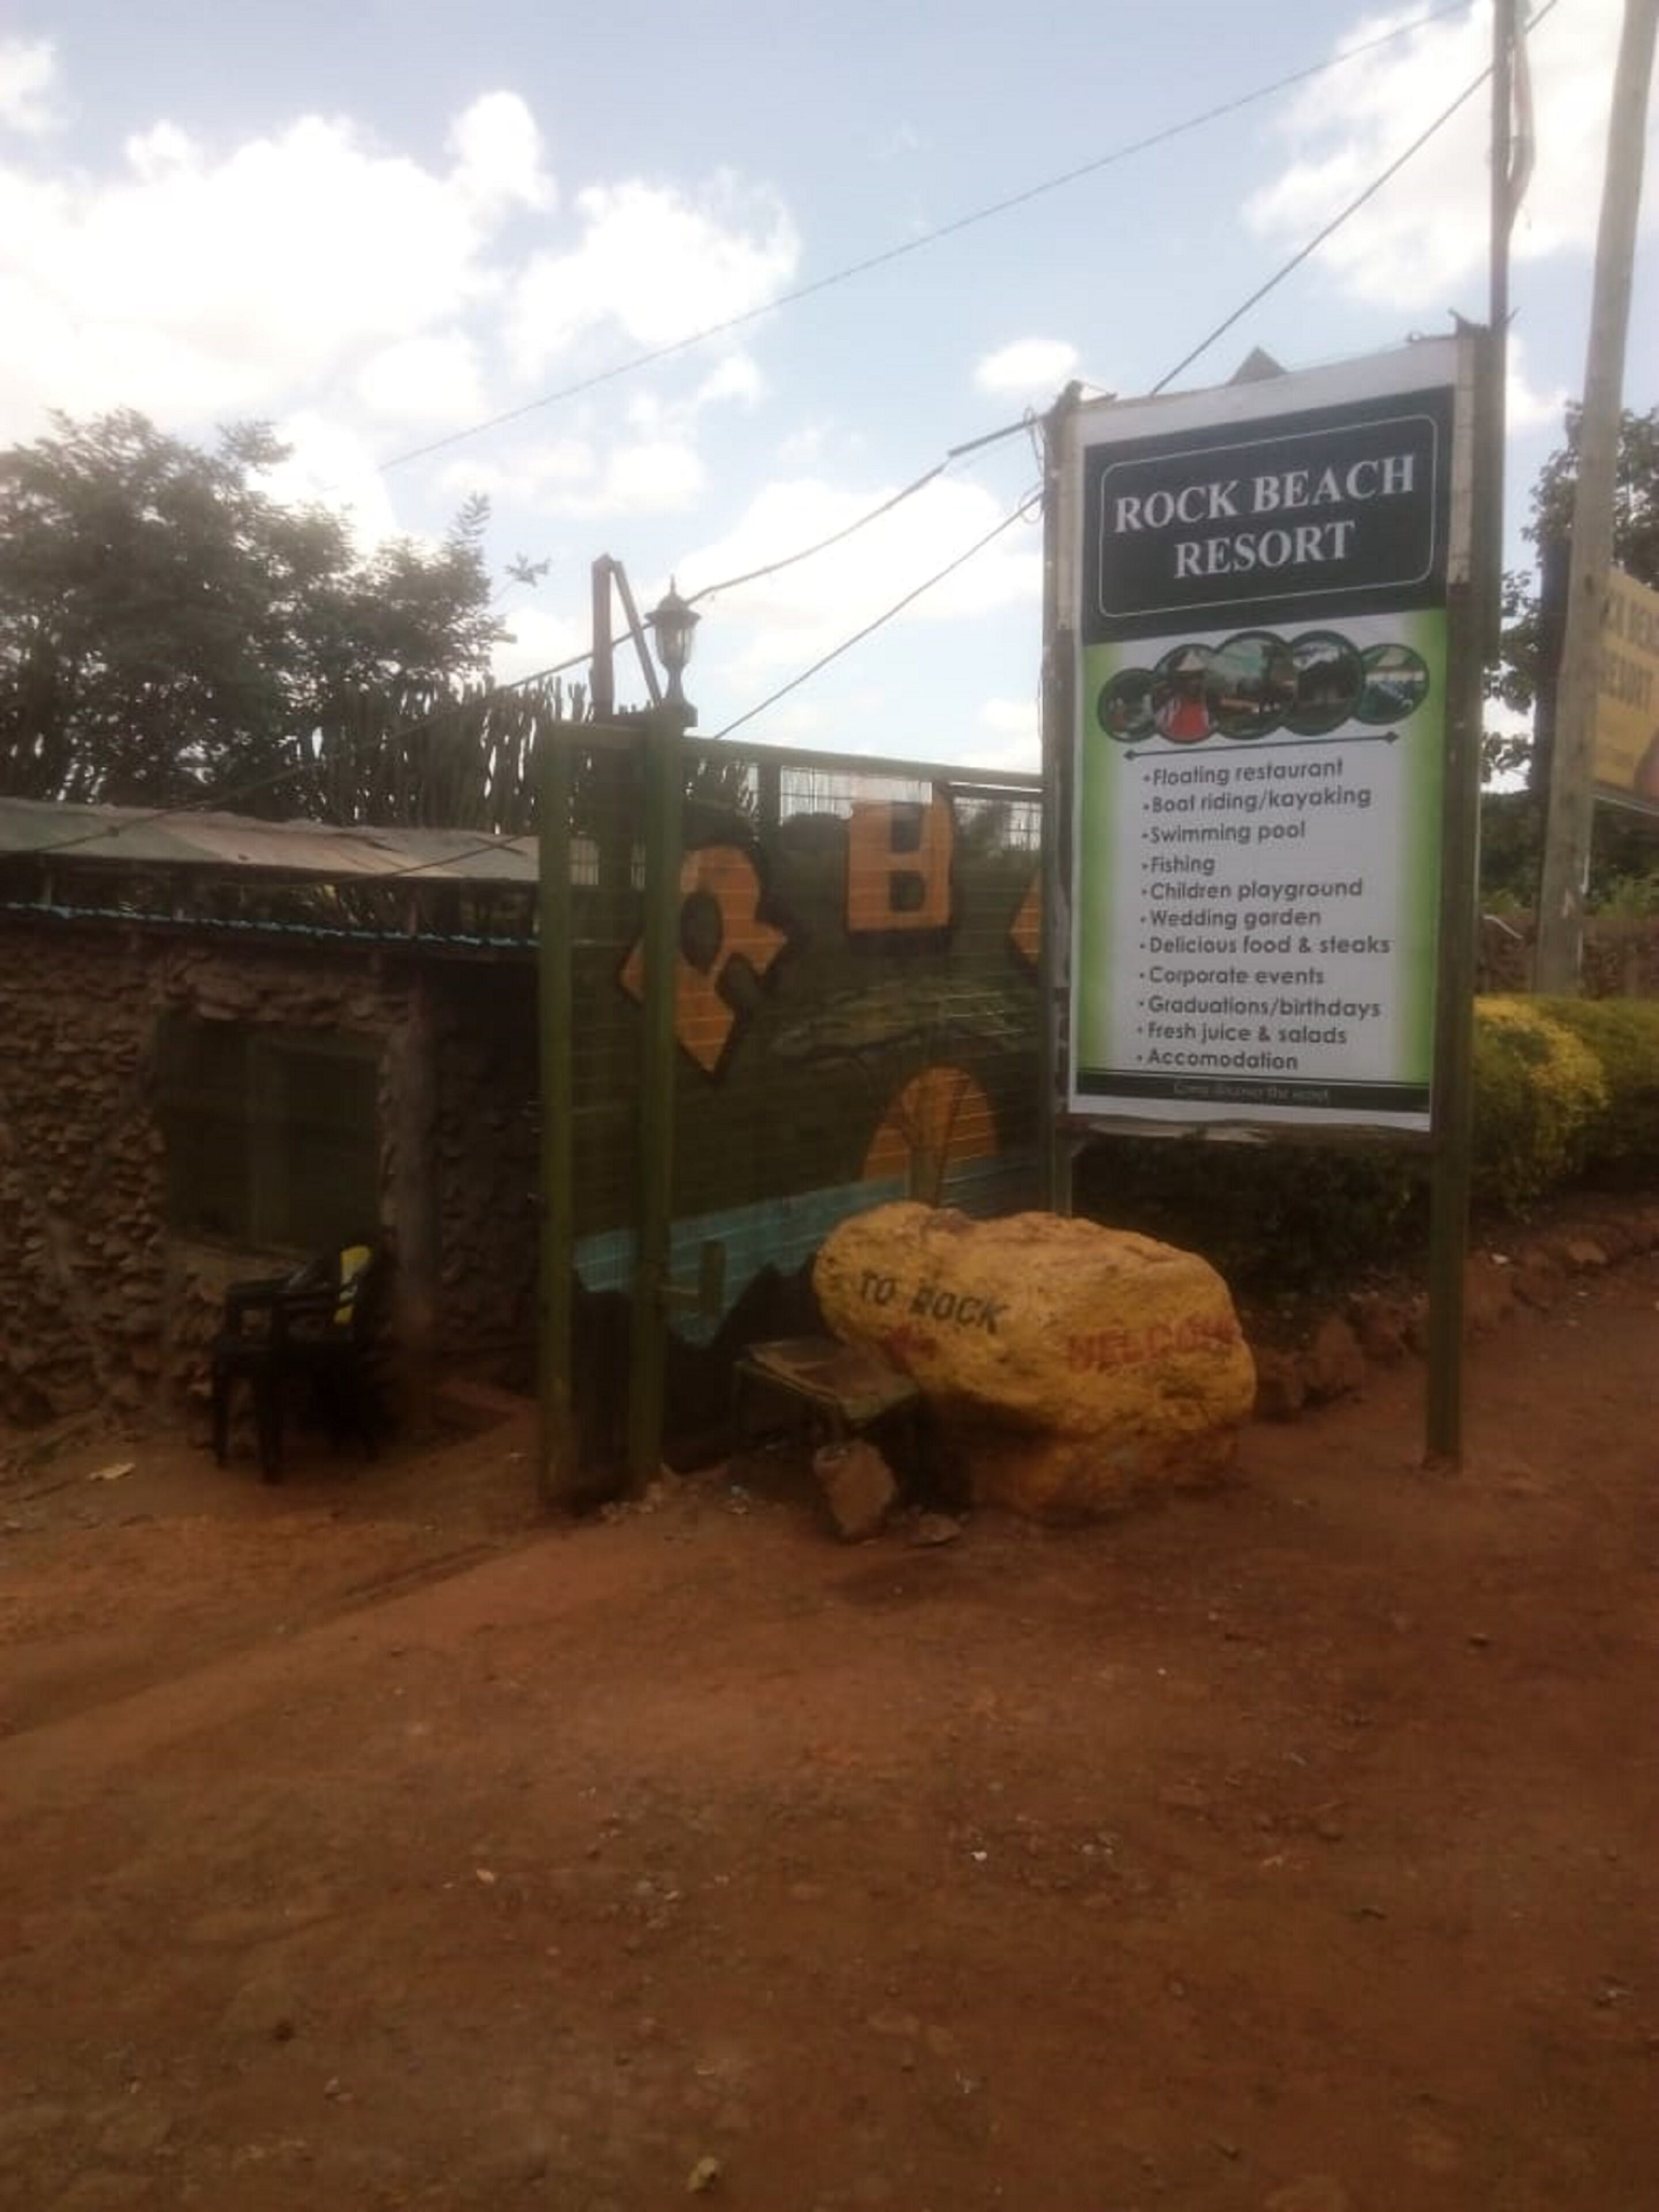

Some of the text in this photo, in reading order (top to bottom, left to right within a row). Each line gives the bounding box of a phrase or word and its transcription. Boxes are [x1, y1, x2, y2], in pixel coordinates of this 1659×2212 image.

[1115, 454, 1415, 533] ROCK BEACH
[1175, 520, 1354, 579] RESORT
[1153, 759, 1343, 785] Floating restaurant
[1152, 786, 1372, 813] Boat riding/kayaking
[1150, 821, 1306, 844] Swimming pool
[1152, 855, 1215, 876] Fishing
[1150, 877, 1363, 902] Children playground
[1151, 908, 1321, 930] Wedding garden
[1150, 935, 1391, 953] Delicious food & steaks
[1150, 966, 1324, 987] Corporate events
[1148, 995, 1381, 1021] Graduations/birthdays
[1147, 1021, 1347, 1044] Fresh juice & salads
[1148, 1048, 1298, 1070] Accomodation
[860, 1267, 1011, 1335] TO ROCK
